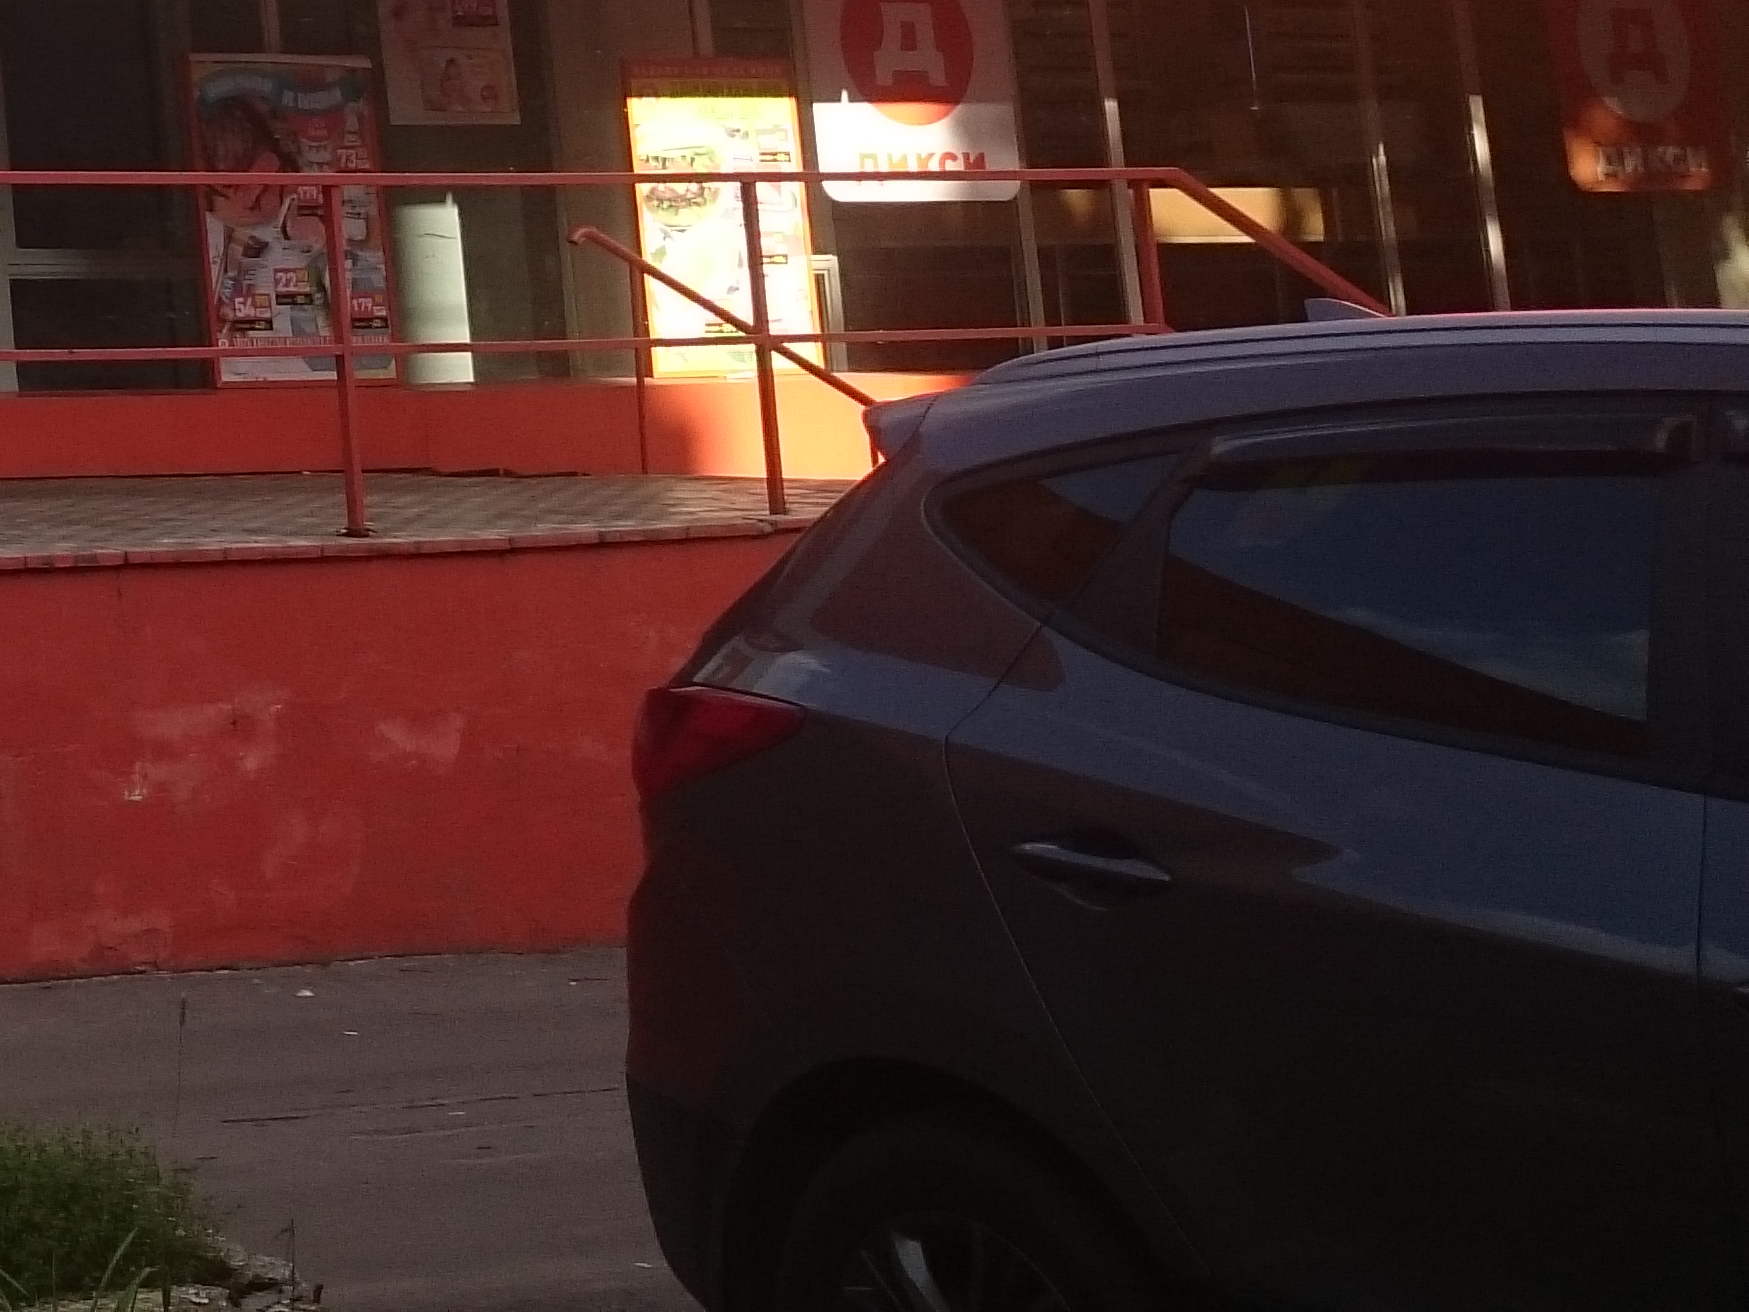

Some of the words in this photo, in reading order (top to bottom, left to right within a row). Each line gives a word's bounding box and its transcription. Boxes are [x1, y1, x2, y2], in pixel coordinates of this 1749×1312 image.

[872, 1, 949, 87] Д
[1606, 7, 1670, 86] Д
[1596, 144, 1709, 182] ДИКСИ
[233, 297, 256, 317] 54
